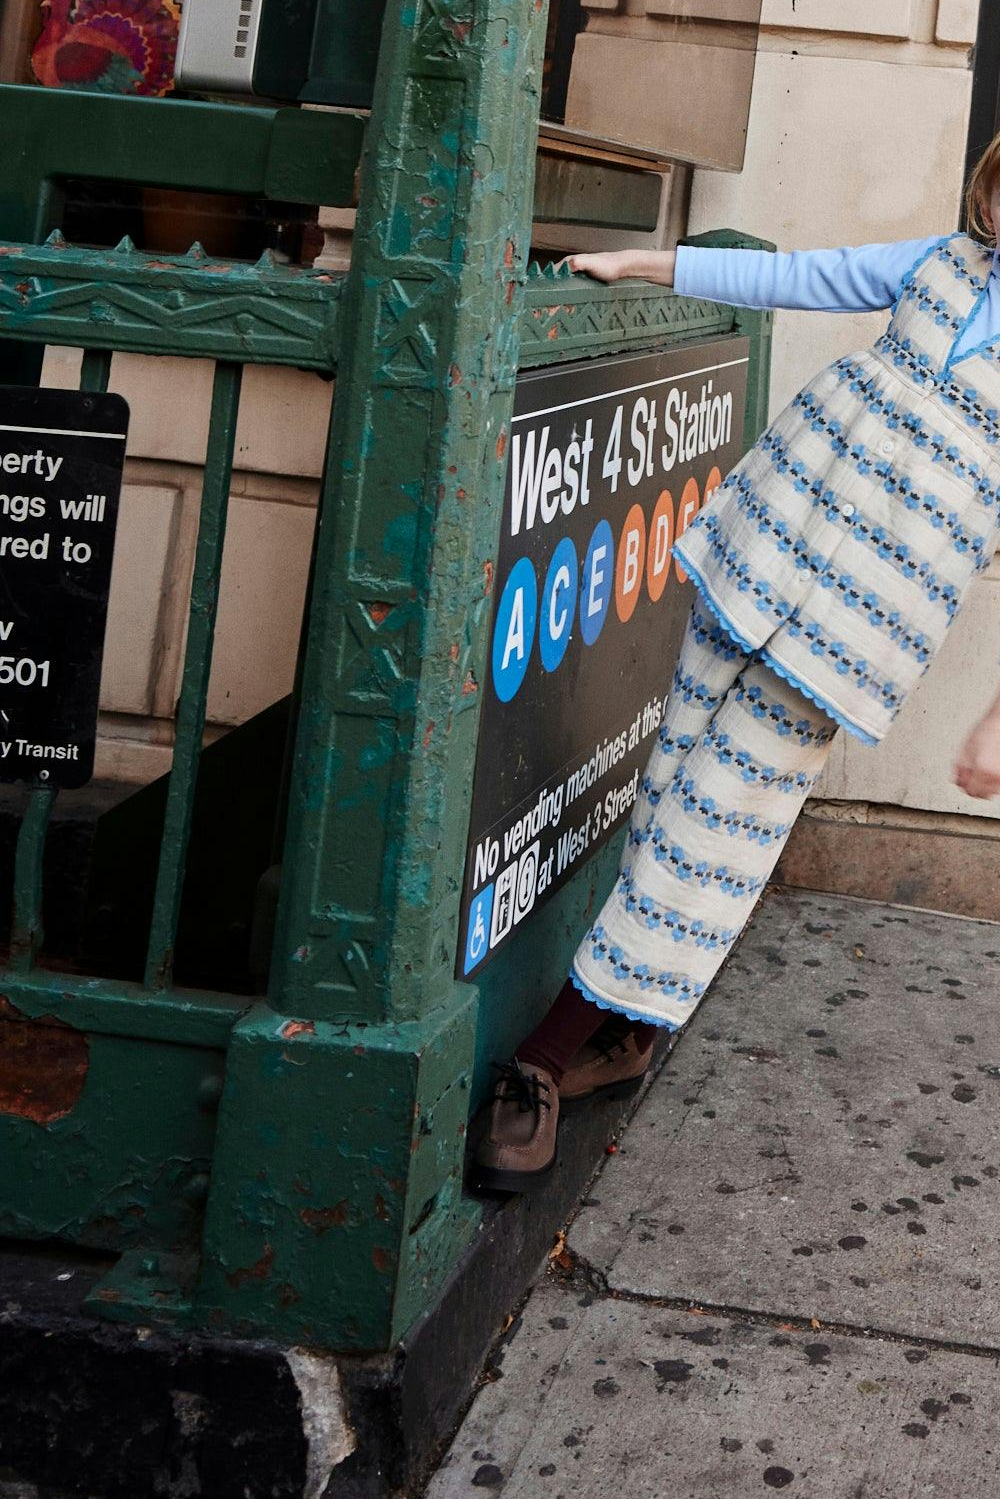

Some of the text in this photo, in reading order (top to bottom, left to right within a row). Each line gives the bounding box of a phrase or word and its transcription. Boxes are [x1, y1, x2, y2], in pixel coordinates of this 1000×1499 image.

[0, 450, 63, 481] erty
[511, 380, 733, 537] West 4 St Station
[60, 494, 106, 522] will
[0, 533, 92, 564] red to
[501, 587, 524, 670] A
[549, 565, 570, 640] C
[588, 545, 607, 617] E
[623, 528, 640, 595] B
[654, 514, 669, 577] D
[0, 656, 50, 687] 501
[15, 739, 79, 760] Transit
[473, 836, 499, 890] No
[504, 784, 565, 861] vending
[565, 730, 628, 806] machines
[628, 712, 641, 751] at
[641, 697, 661, 738] this
[538, 767, 639, 895] at West 3 Street
